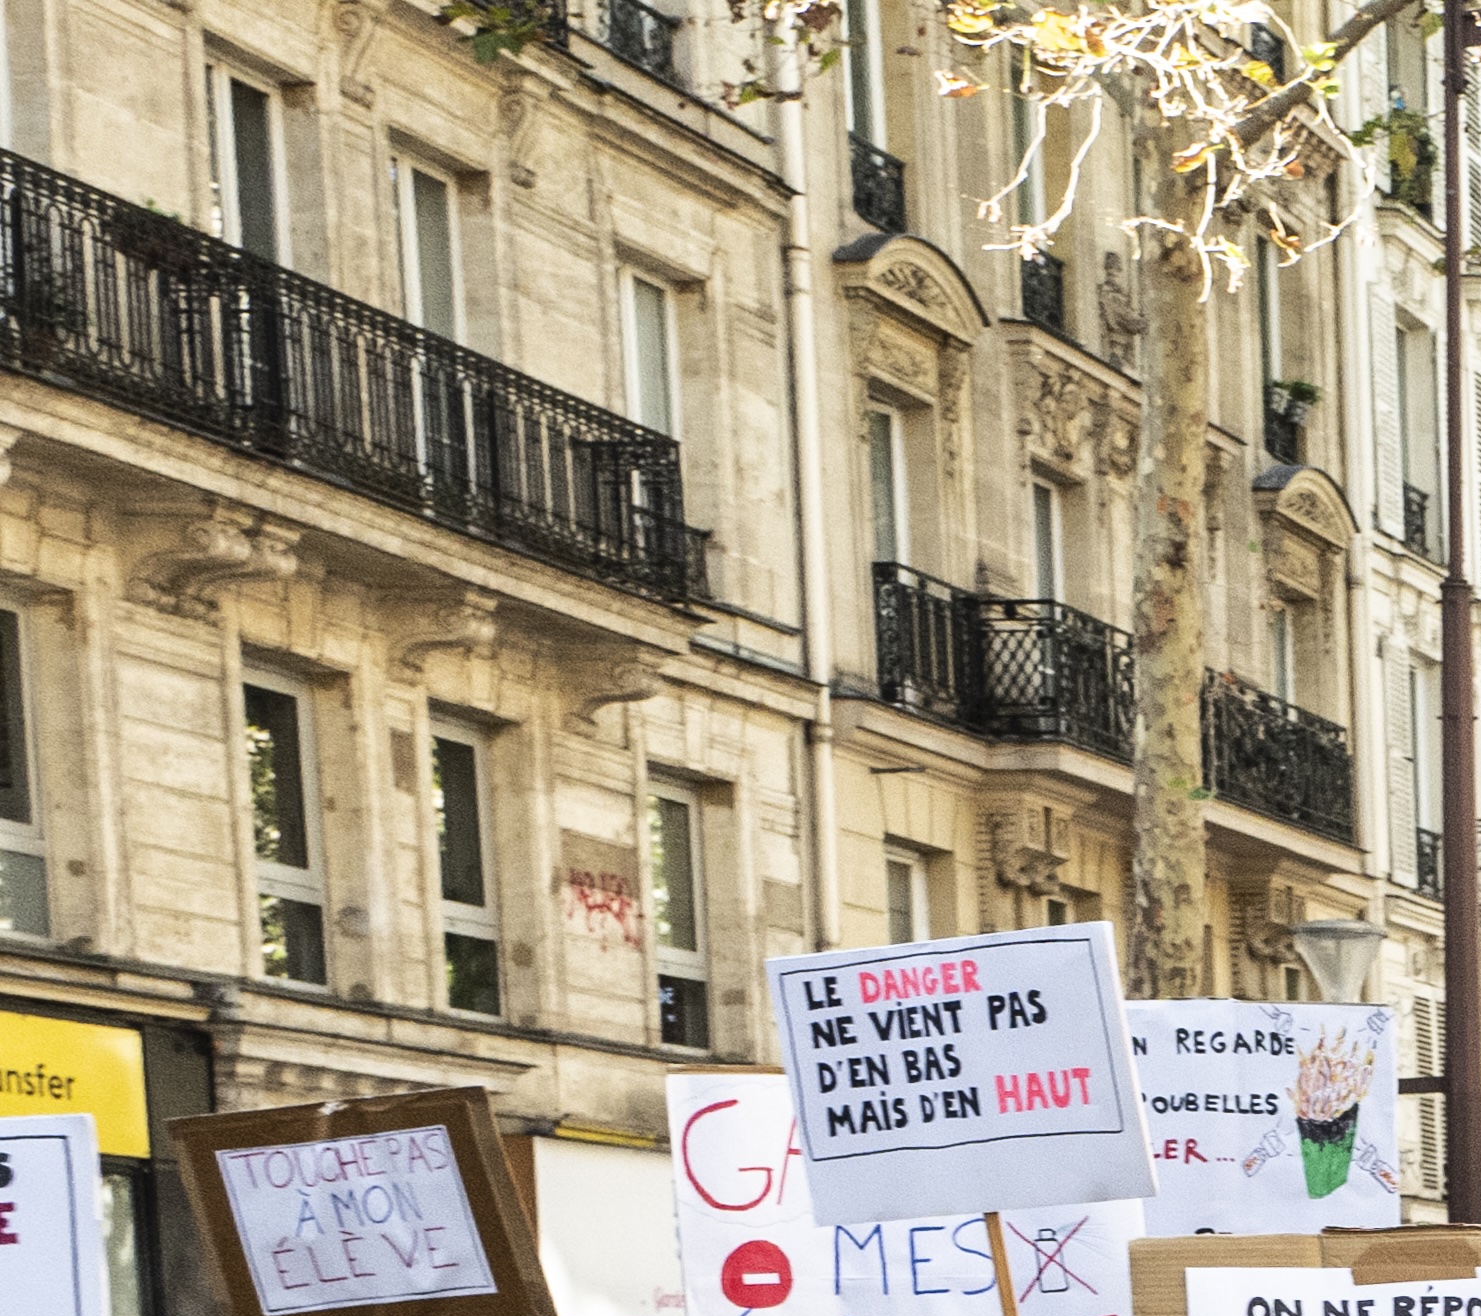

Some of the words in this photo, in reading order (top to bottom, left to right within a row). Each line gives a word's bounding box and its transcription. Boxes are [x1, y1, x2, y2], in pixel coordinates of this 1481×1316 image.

[803, 977, 842, 1010] LE
[859, 959, 982, 1004] DANGER
[811, 1016, 857, 1049] NE
[987, 990, 1047, 1031] PAS
[1131, 1037, 1148, 1056] N
[817, 1055, 890, 1094] D'EN
[903, 1043, 961, 1084] BAS
[922, 1087, 981, 1124] D'EN
[994, 1067, 1091, 1114] HAUT
[1141, 1093, 1279, 1116] OUBELLES
[230, 1139, 387, 1190] TOUCHE
[389, 1132, 451, 1174] PAS
[294, 1187, 324, 1237] À
[330, 1181, 423, 1228] MON
[271, 1226, 460, 1290] ÉLÈVE
[834, 1218, 998, 1296] MES
